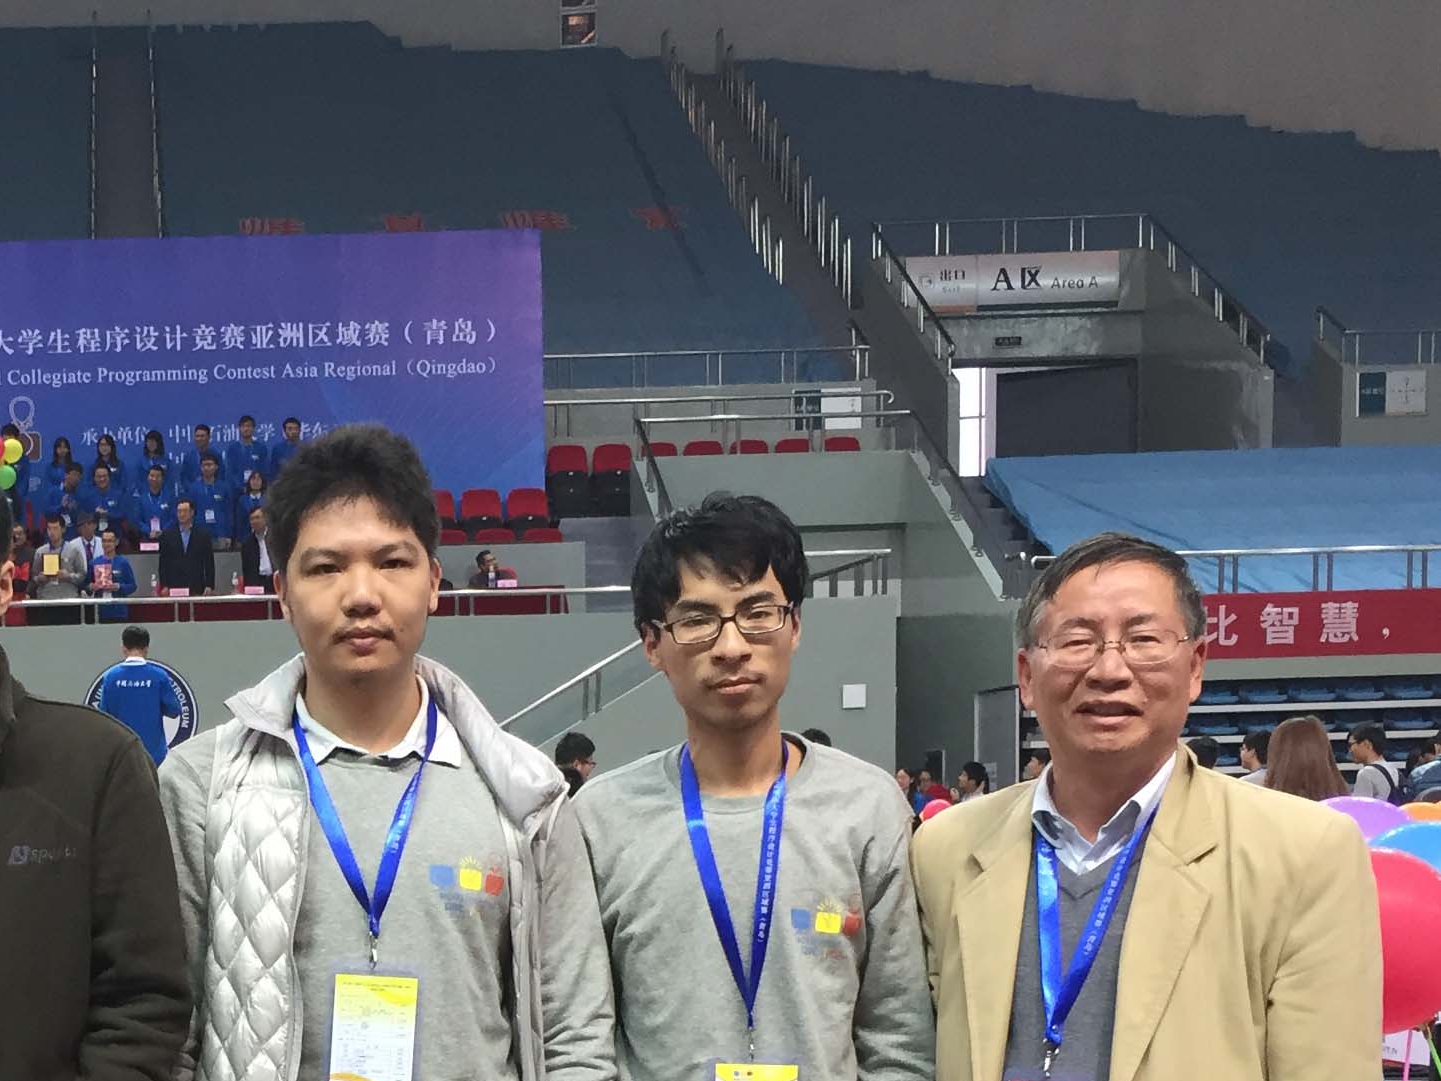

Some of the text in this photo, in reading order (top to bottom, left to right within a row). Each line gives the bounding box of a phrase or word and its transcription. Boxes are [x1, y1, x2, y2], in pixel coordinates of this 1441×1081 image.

[1051, 277, 1084, 289] Area
[1089, 276, 1098, 288] A
[8, 369, 92, 388] Collegiate
[96, 364, 208, 386] Programming
[213, 363, 275, 380] Contest
[282, 361, 318, 378] Asia
[324, 360, 396, 380] Regional
